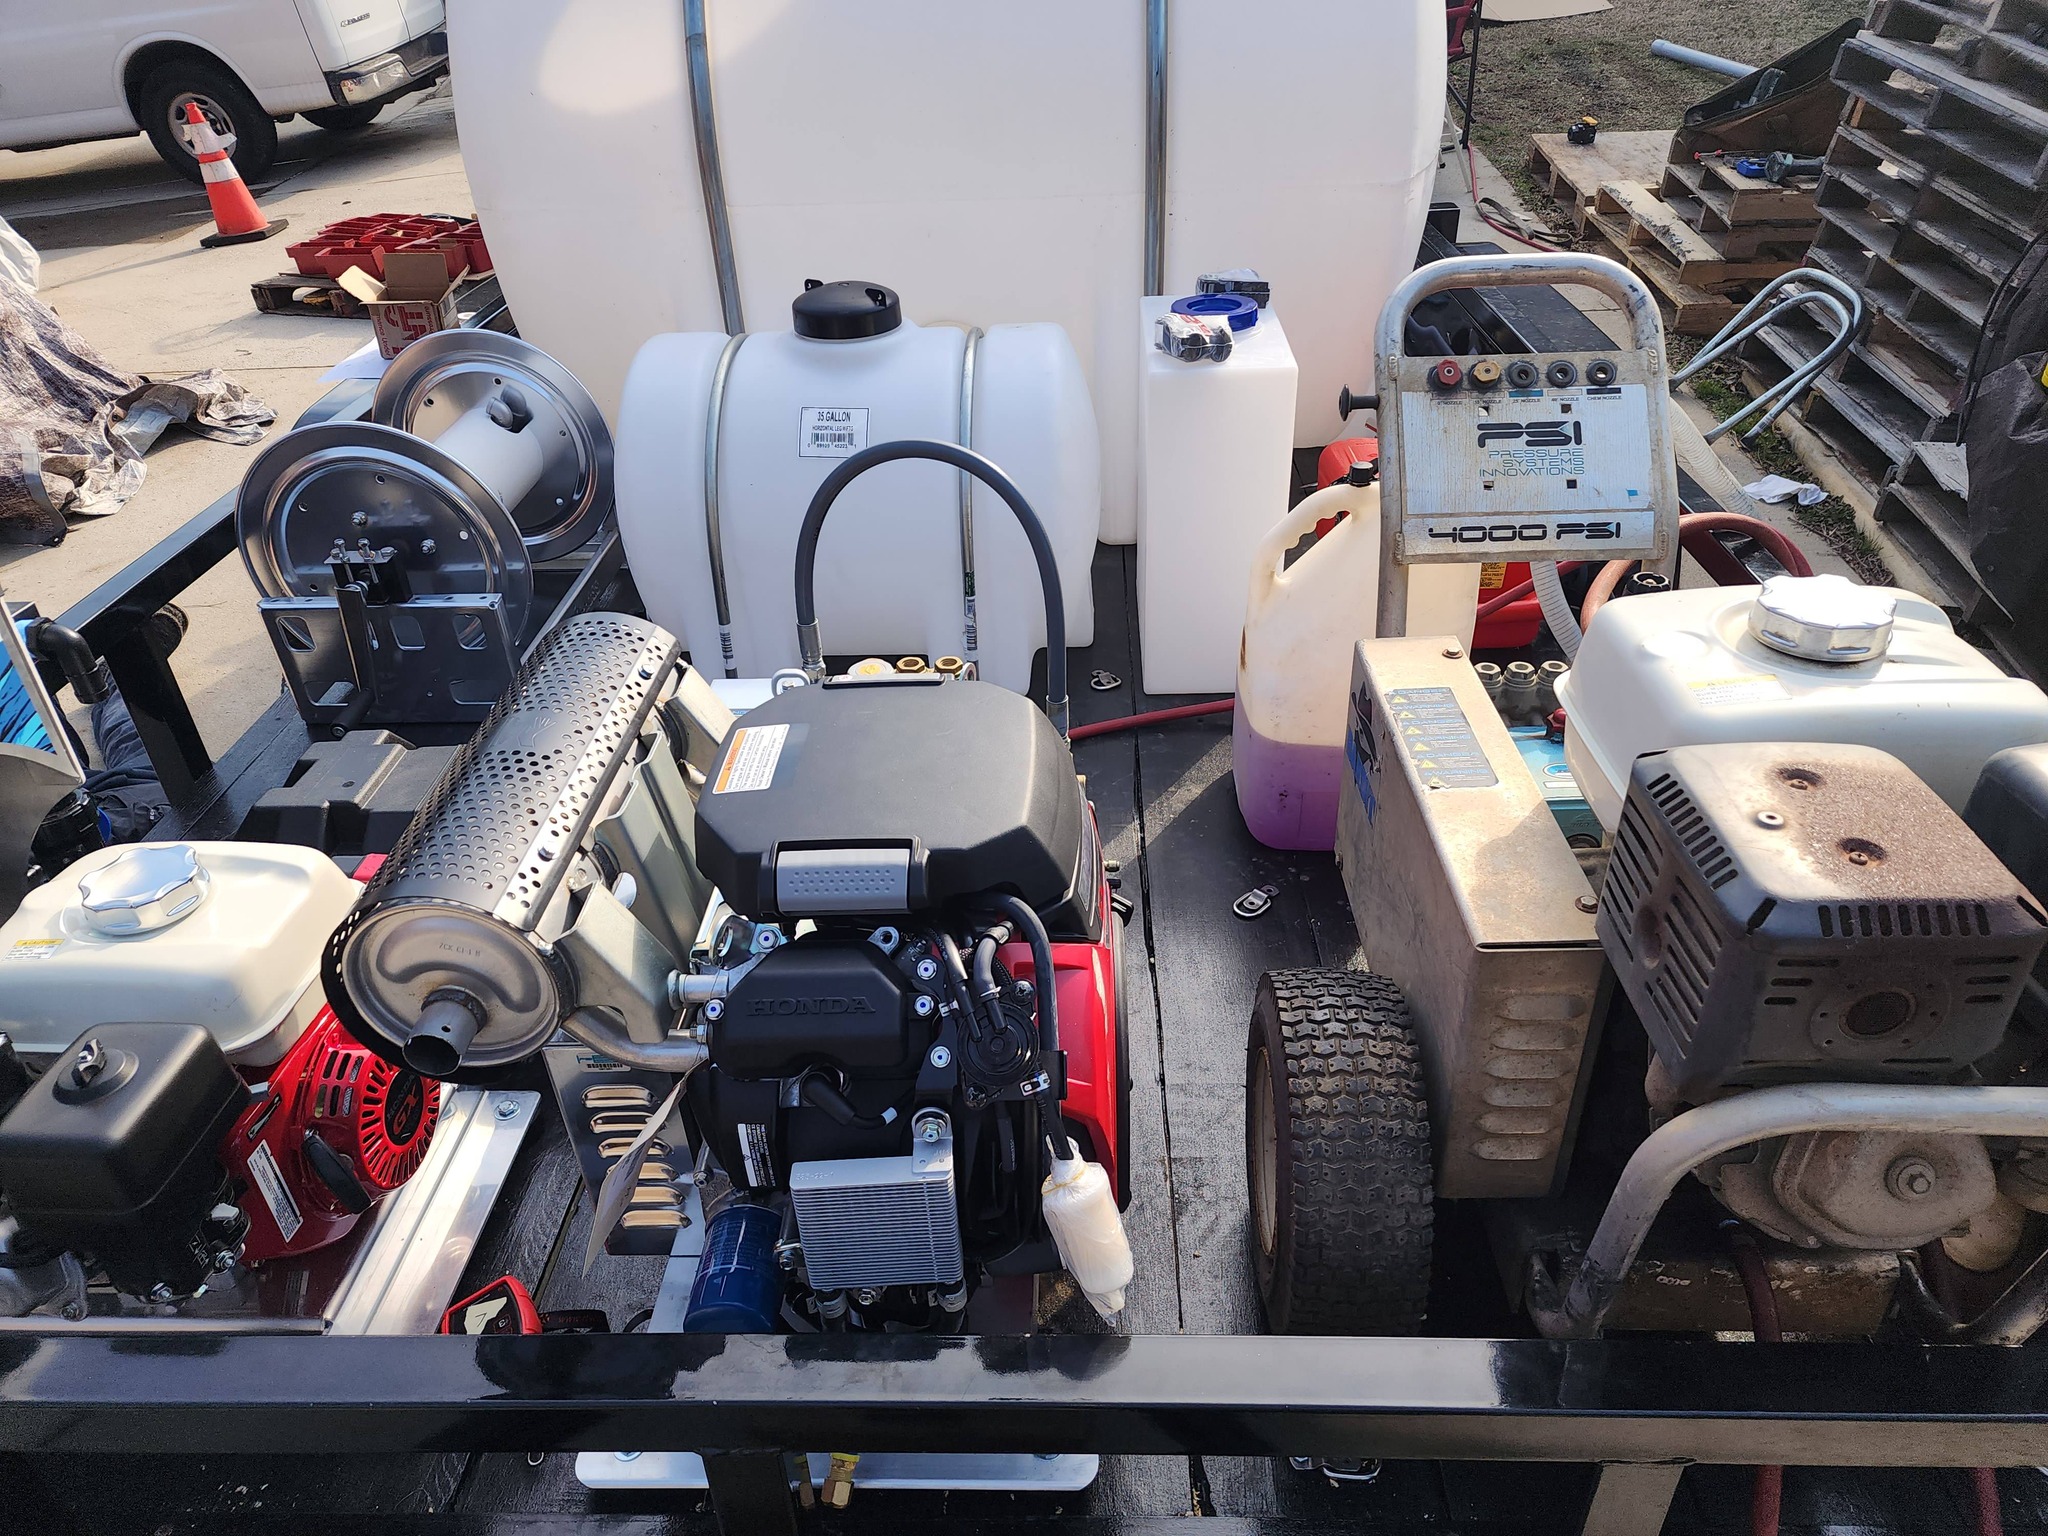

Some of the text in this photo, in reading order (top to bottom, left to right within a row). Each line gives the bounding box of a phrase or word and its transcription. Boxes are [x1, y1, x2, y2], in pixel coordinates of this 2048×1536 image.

[817, 411, 851, 422] 35 GALLON
[1477, 421, 1583, 449] PSI
[1488, 448, 1584, 459] PRESSURE
[1502, 457, 1585, 467] SYSTEMS
[1479, 467, 1585, 477] INNOVATIONS
[1428, 522, 1621, 543] 4000 PSI
[746, 996, 876, 1017] HONDA
[393, 1083, 419, 1135] GX
